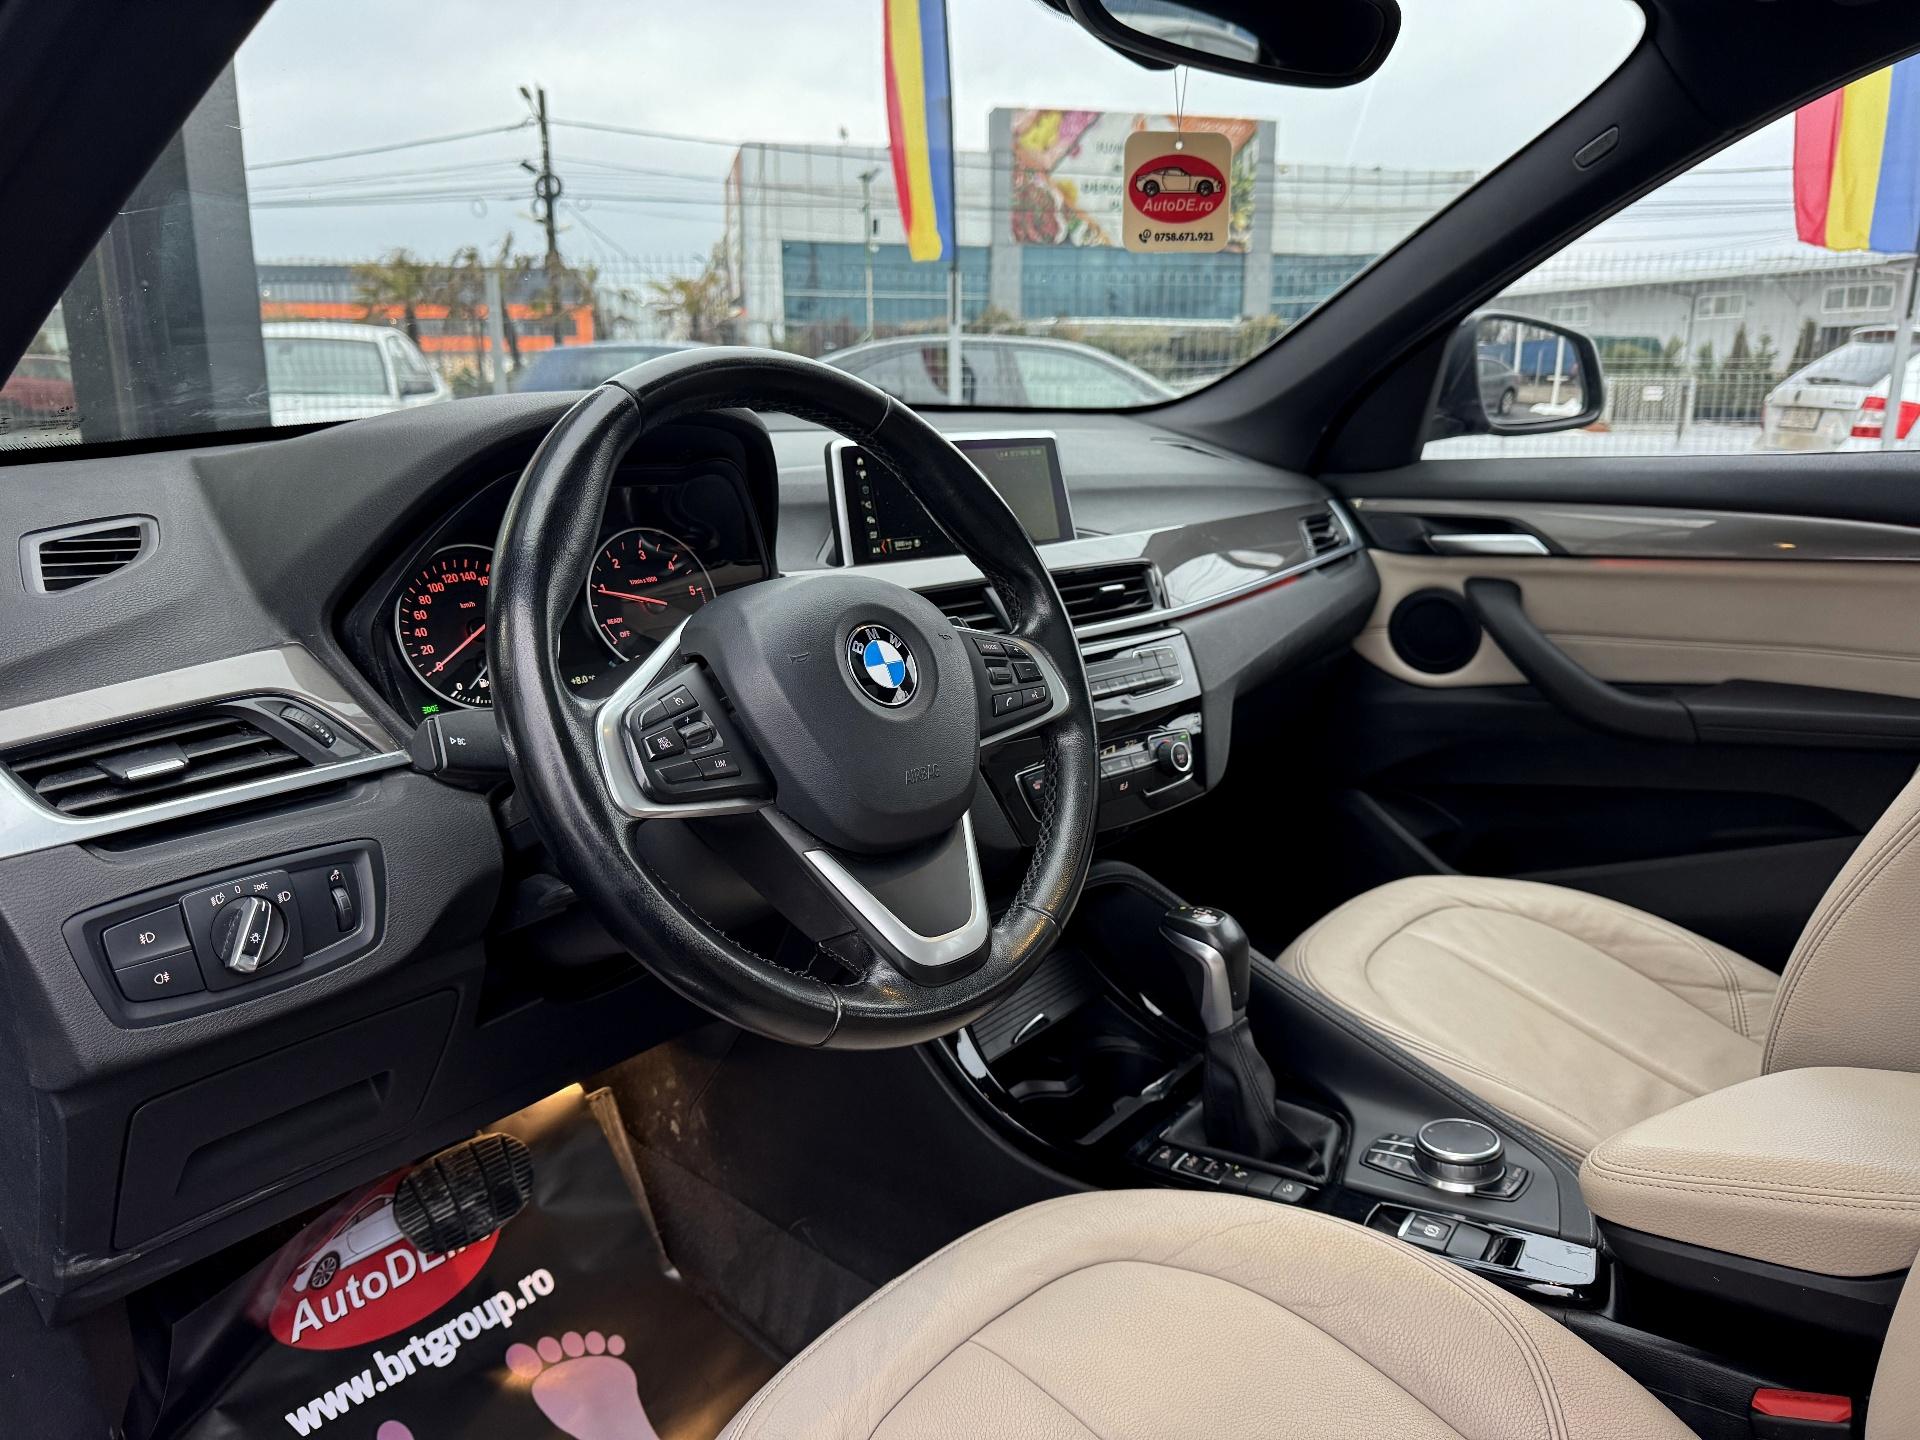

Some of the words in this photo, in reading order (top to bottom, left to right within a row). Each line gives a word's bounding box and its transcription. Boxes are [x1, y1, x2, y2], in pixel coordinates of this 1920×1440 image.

[1142, 199, 1214, 212] AutoDE.ro
[1154, 232, 1214, 242] 0758.671.921
[639, 550, 646, 560] 3
[612, 559, 620, 568] 2
[668, 561, 674, 571] 4
[442, 573, 458, 584] 120
[460, 571, 476, 581] 140
[478, 575, 489, 587] 16
[427, 583, 444, 593] 100
[689, 586, 696, 596] 5
[418, 595, 432, 605] 80
[413, 610, 427, 620] 60
[415, 628, 427, 637] 40
[851, 627, 902, 656] BMW
[421, 645, 434, 655] 20
[571, 676, 588, 685] +8.0
[284, 1267, 555, 1437] www.brtgroup.ro
